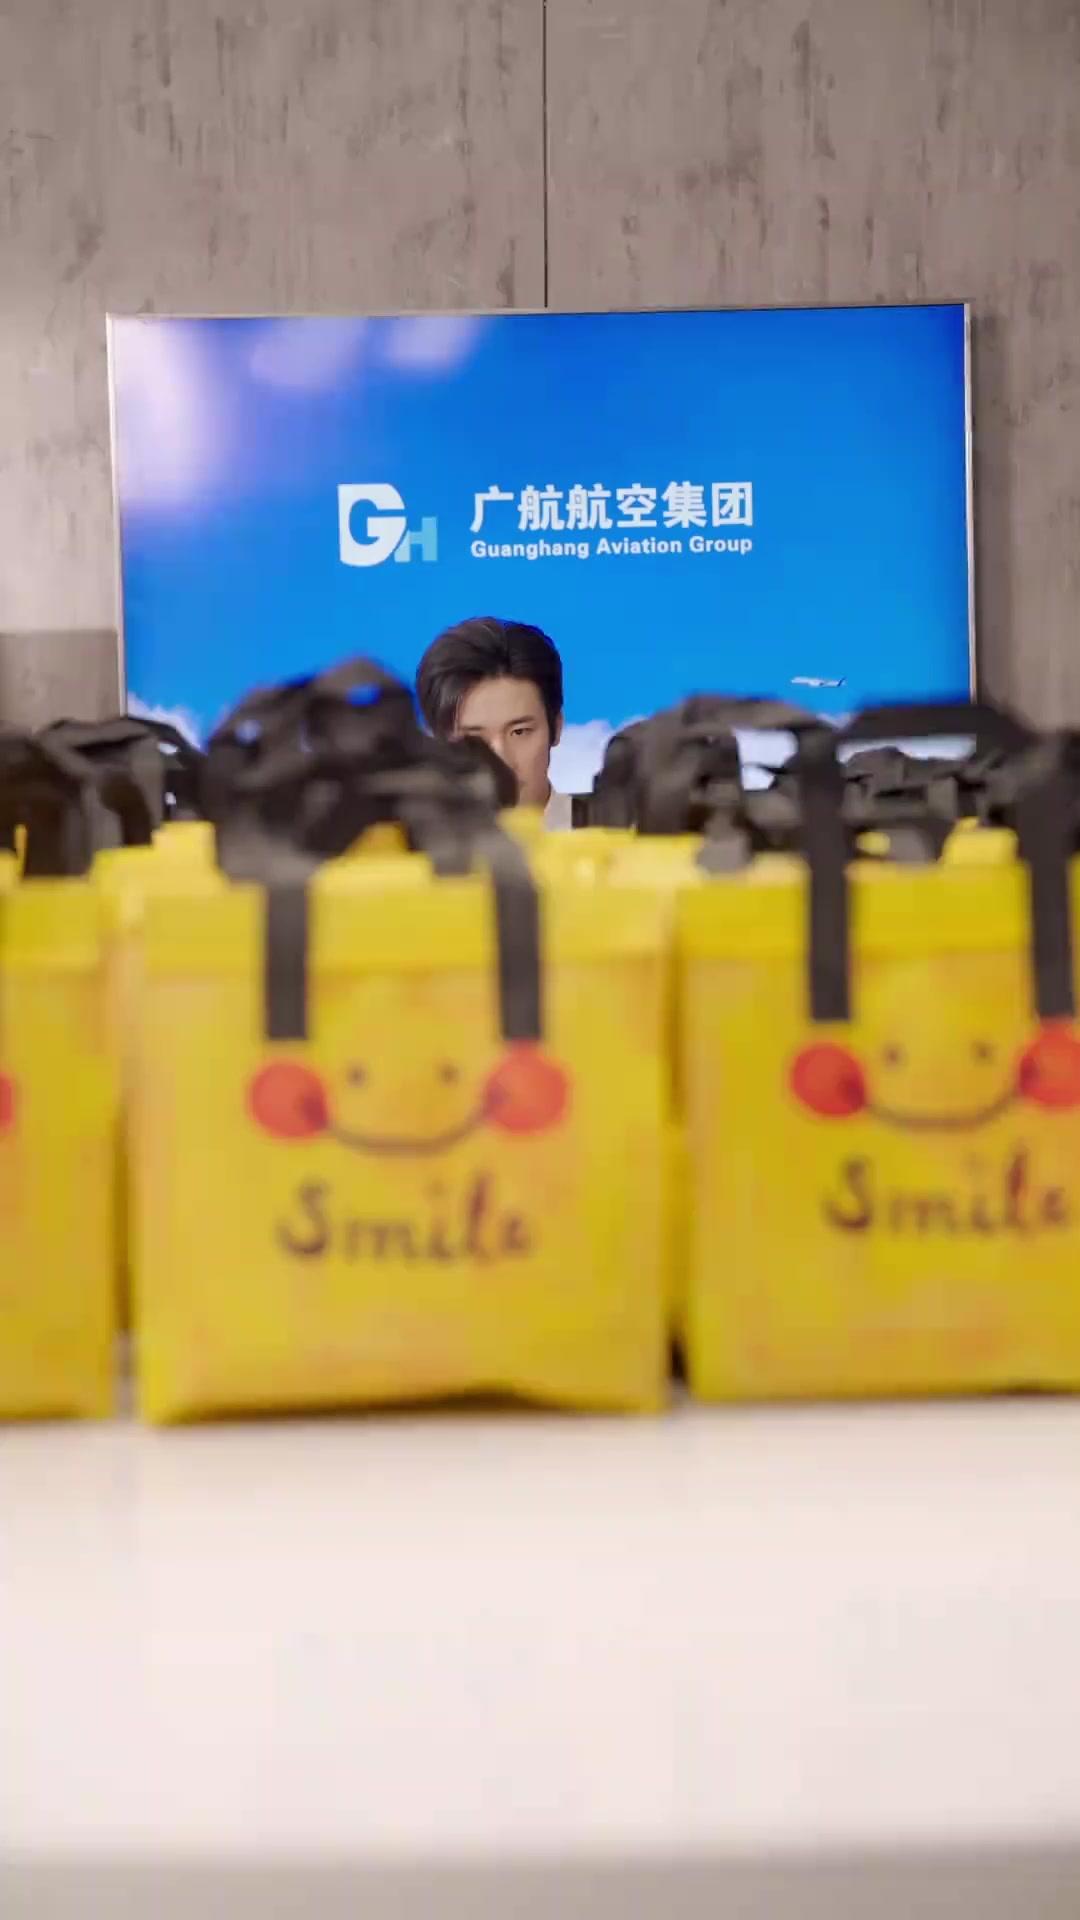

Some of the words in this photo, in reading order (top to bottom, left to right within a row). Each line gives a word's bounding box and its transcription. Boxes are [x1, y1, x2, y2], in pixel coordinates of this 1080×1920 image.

[470, 481, 753, 533] 广航航空集团
[471, 540, 590, 561] Guanghang
[596, 537, 682, 556] Aviation
[689, 535, 753, 556] Group
[274, 1170, 536, 1266] Smile
[820, 1144, 1070, 1237] Smile
